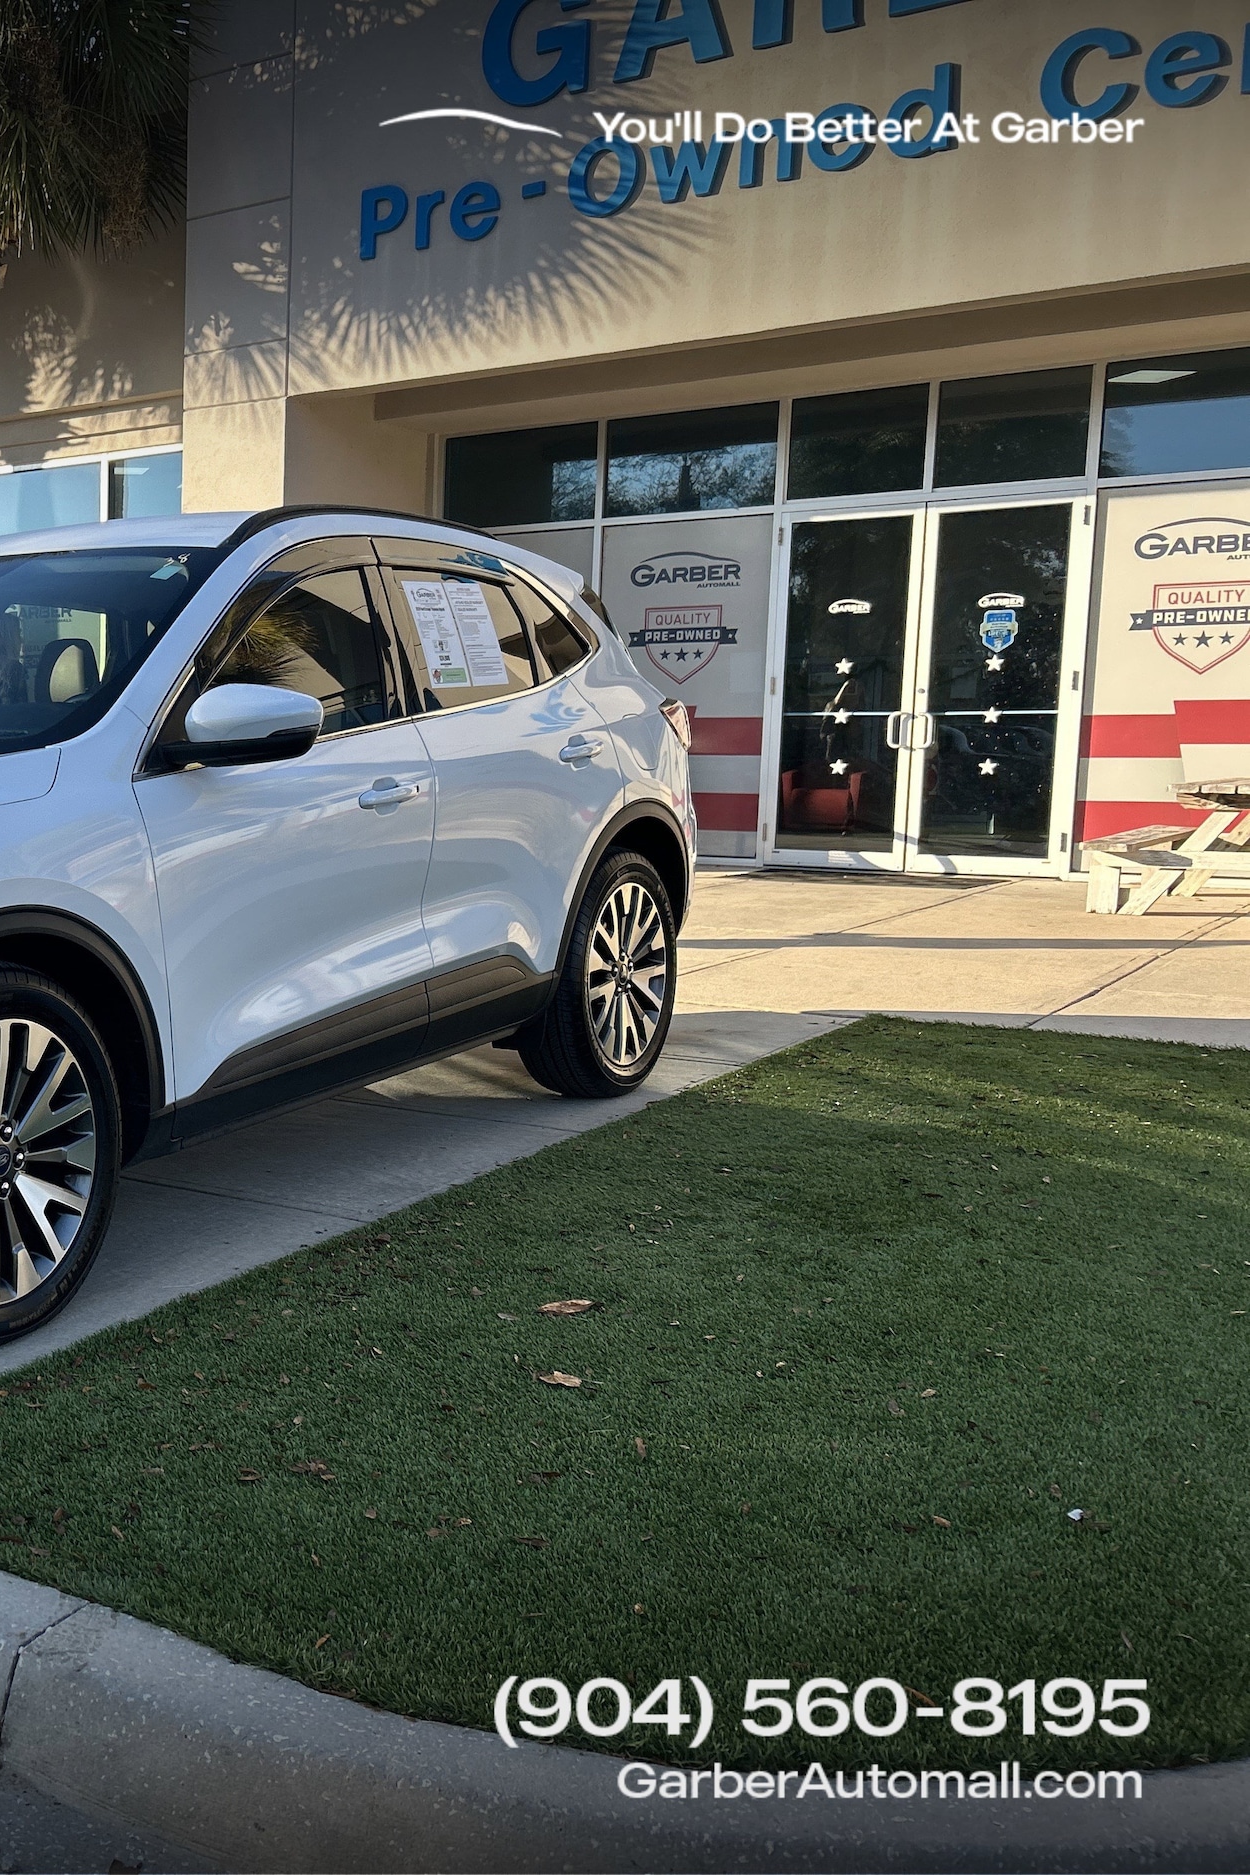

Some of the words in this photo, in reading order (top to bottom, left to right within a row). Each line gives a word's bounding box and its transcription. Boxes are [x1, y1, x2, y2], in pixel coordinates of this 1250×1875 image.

[482, 0, 975, 107] GA
[630, 564, 741, 588] GARBER
[696, 581, 741, 589] AUTOMALL
[1168, 589, 1246, 605] QUALITY
[655, 612, 711, 626] QUALITY
[1152, 609, 1250, 625] PRE-OWNE
[644, 629, 721, 642] PRE-OWNED
